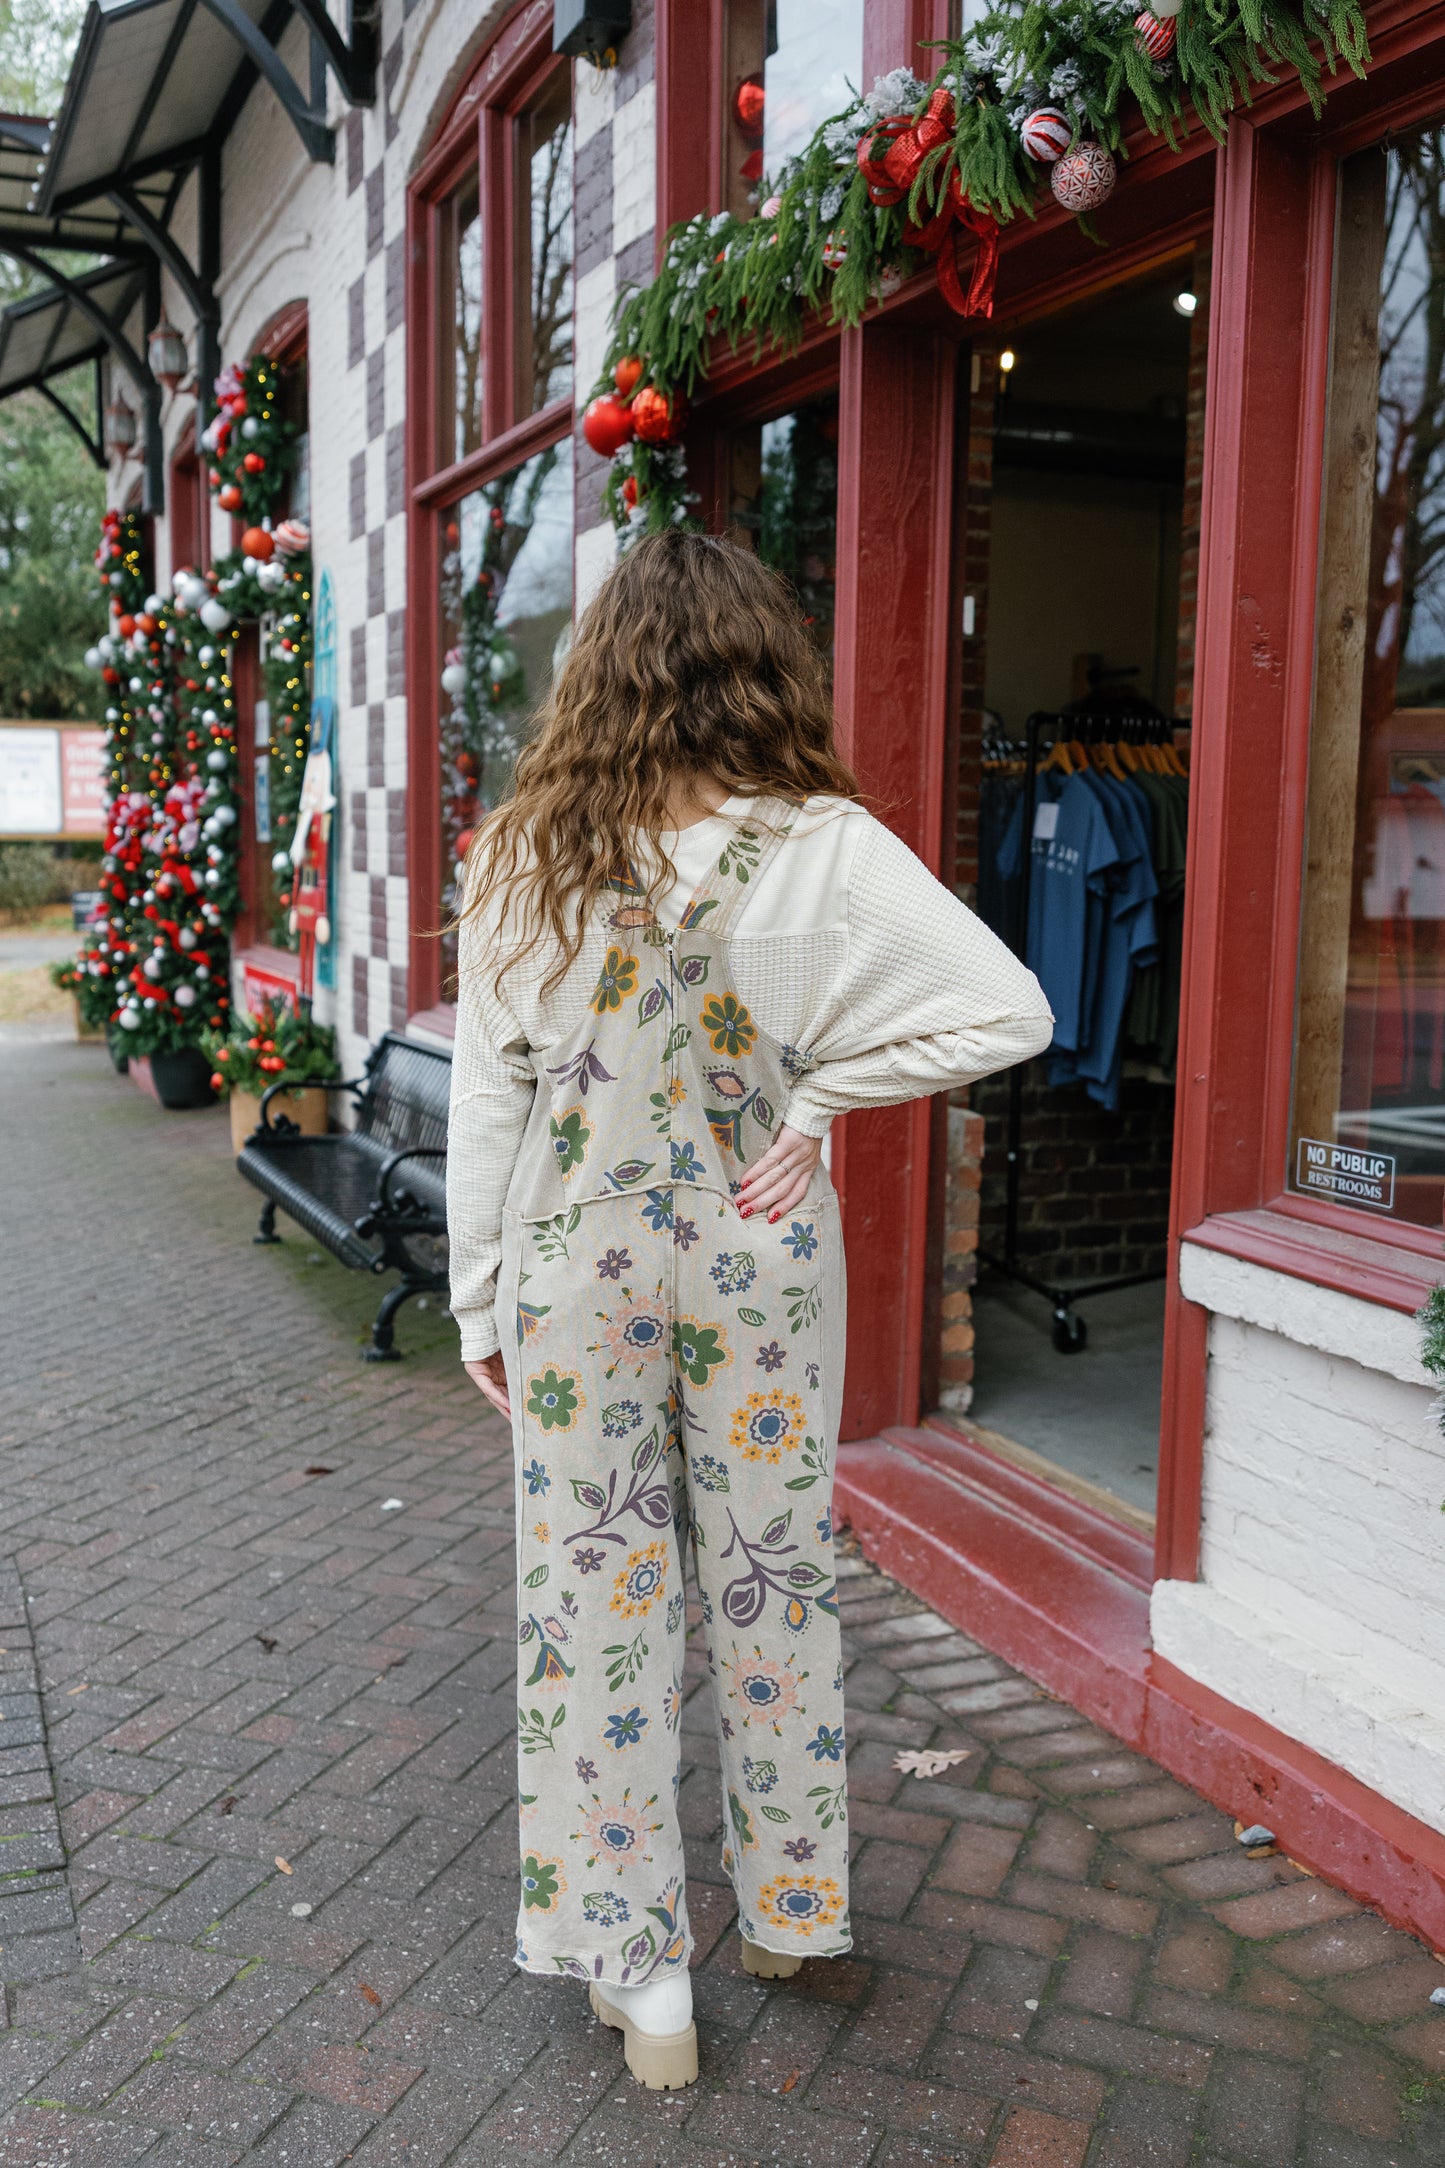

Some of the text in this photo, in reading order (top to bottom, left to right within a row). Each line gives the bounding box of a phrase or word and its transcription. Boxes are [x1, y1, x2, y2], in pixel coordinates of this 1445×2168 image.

[1307, 1145, 1386, 1178] NO PUBLIC
[1307, 1171, 1383, 1200] RESTROOMS
